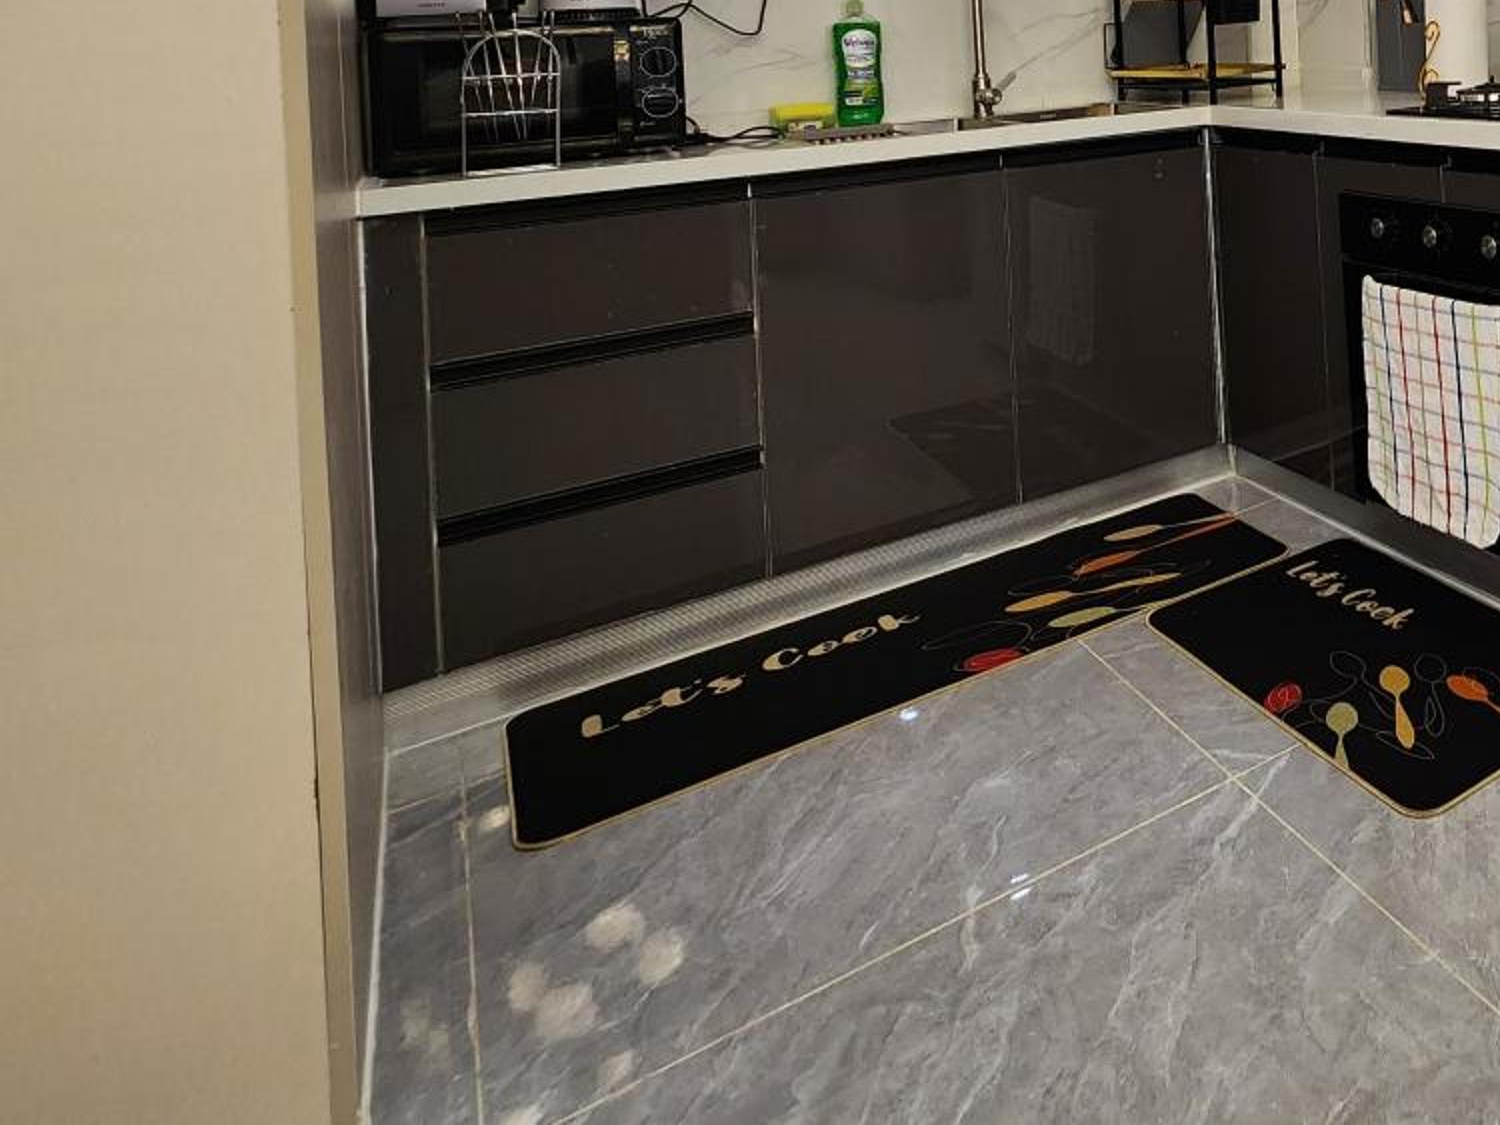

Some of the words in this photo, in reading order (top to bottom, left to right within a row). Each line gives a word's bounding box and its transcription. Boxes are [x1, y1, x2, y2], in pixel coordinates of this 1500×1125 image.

[1286, 560, 1346, 597] Let's
[1342, 588, 1415, 629] Cook
[581, 673, 746, 738] Let's
[762, 615, 920, 671] Cook
